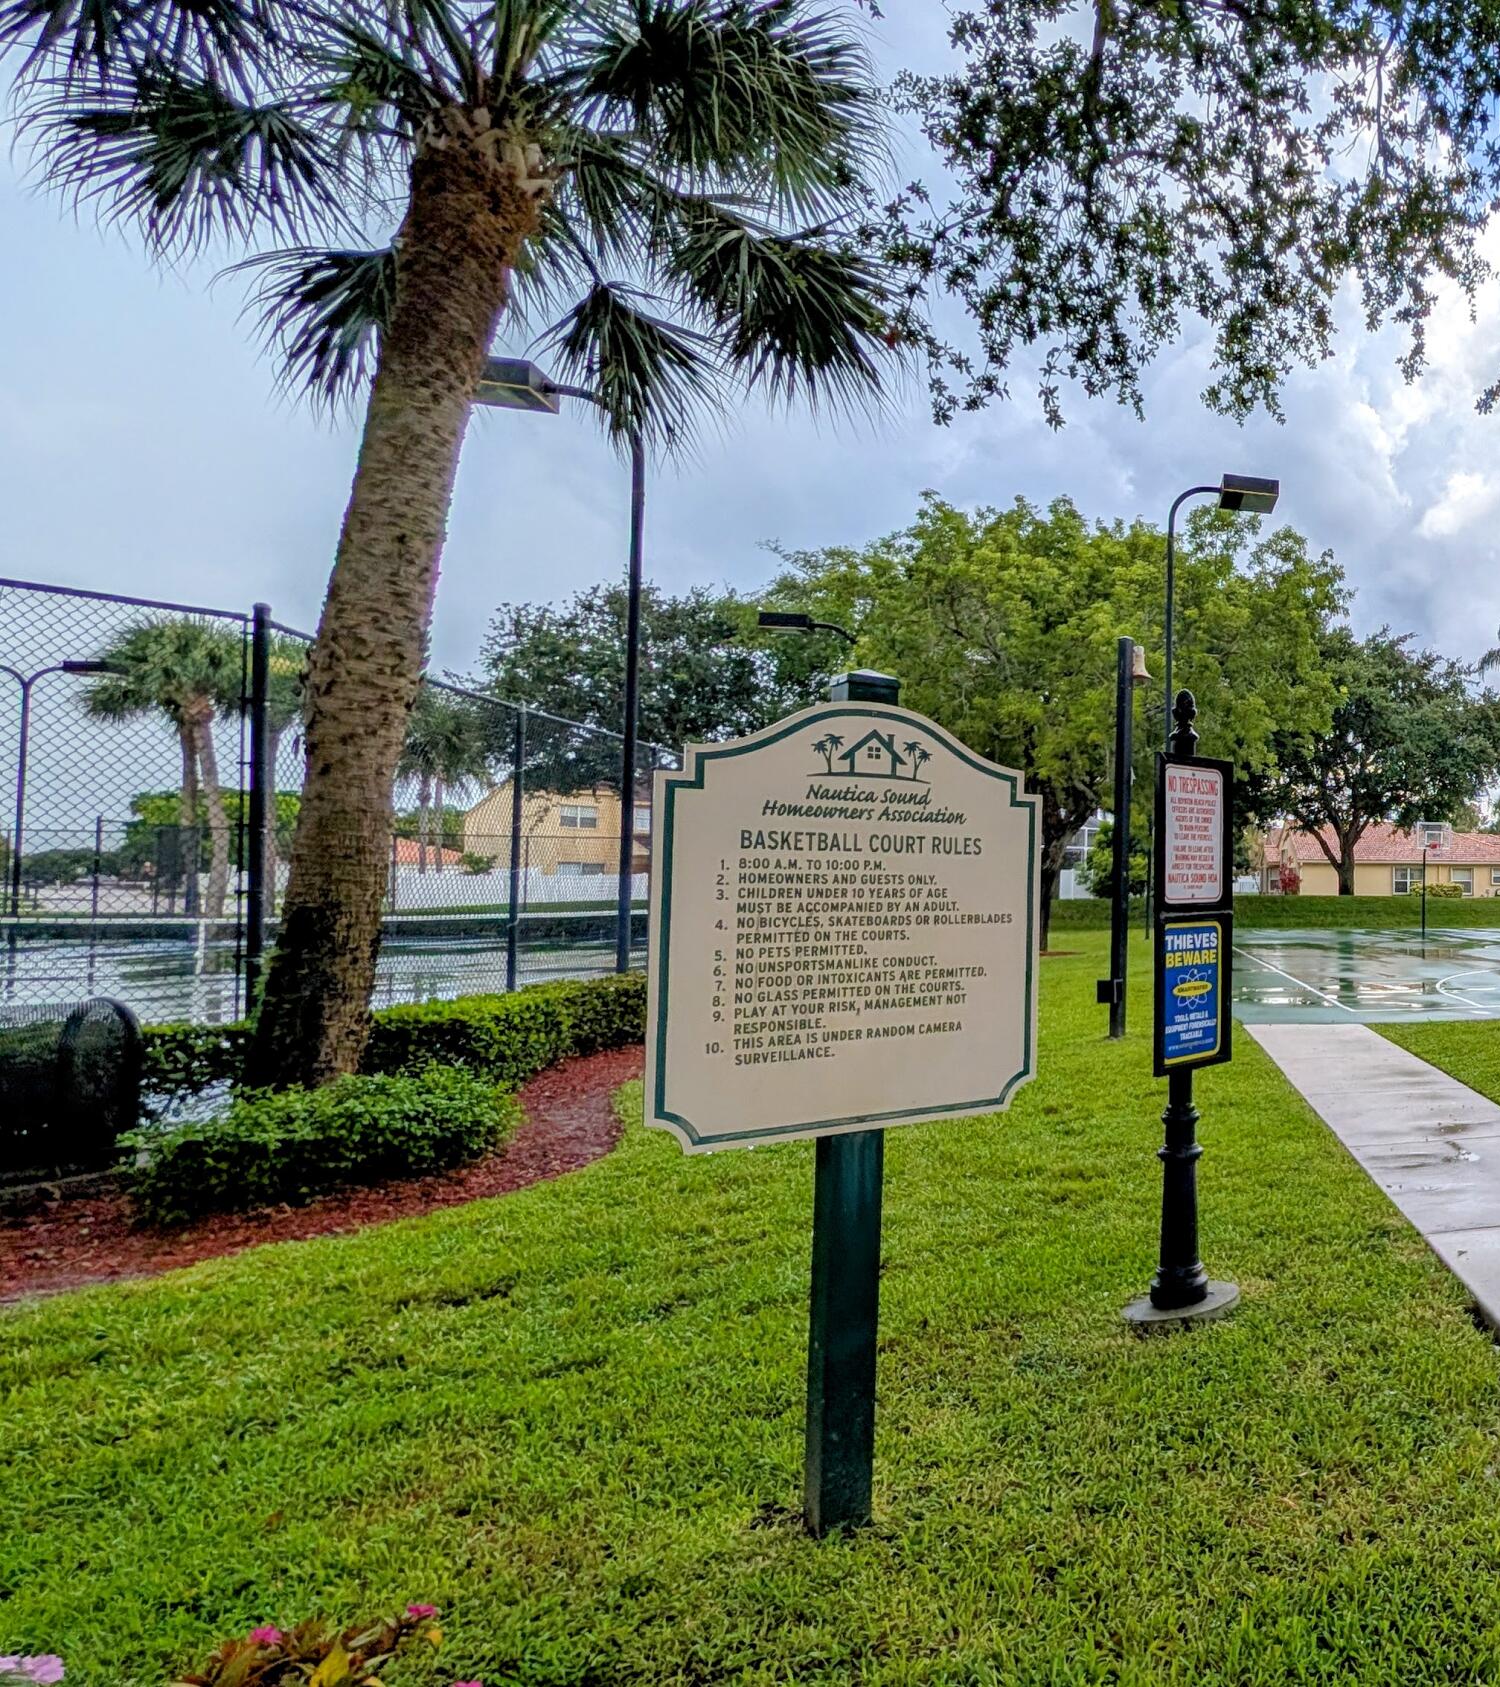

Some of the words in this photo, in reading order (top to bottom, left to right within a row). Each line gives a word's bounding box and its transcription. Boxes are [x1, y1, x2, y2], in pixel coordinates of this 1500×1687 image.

[806, 784, 879, 803] Nautica
[880, 788, 932, 806] Sound
[1168, 775, 1177, 793] NO
[1179, 777, 1218, 796] TRESPASSING
[762, 800, 875, 821] Homeowners
[877, 806, 967, 825] Association
[739, 829, 863, 852] BASKETBALL
[869, 834, 926, 854] COURT
[931, 836, 983, 856] RULES
[720, 859, 730, 871] 1.
[739, 858, 770, 869] 8:00
[774, 859, 802, 870] A.M.
[807, 859, 822, 870] TO
[826, 860, 860, 870] 10:00
[863, 860, 886, 871] P.M.
[716, 874, 730, 886] 2.
[738, 872, 828, 885] HOMEOWNERS
[832, 874, 857, 885] AND
[860, 874, 904, 885] GUESTS
[908, 874, 937, 886] ONLY.
[1168, 873, 1189, 883] NAUTICA
[1190, 873, 1207, 883] SOUND
[1208, 873, 1217, 883] HOA
[716, 889, 729, 901] 3.
[738, 887, 802, 899] CHILDREN
[807, 887, 848, 899] UNDER
[852, 888, 865, 899] 10
[869, 888, 906, 899] YEARS
[909, 888, 923, 899] OF
[927, 888, 948, 899] AGE
[736, 902, 772, 914] MUST
[776, 902, 792, 914] BE
[796, 901, 883, 913] ACCOMPANIED
[887, 902, 901, 913] BY
[905, 901, 920, 912] AN
[923, 901, 960, 912] ADULT.
[714, 919, 728, 931] 4.
[737, 916, 755, 929] NO
[760, 916, 824, 929] BICYCLES,
[828, 914, 912, 927] SKATEBOARDS
[915, 914, 930, 926] OR
[933, 913, 1013, 926] ROLLERBLADES
[736, 931, 810, 945] PERMITTED
[814, 930, 831, 942] ON
[835, 930, 858, 942] THE
[861, 930, 910, 941] COURTS.
[1165, 932, 1218, 951] THIEVES
[714, 950, 727, 962] 5.
[736, 947, 755, 960] NO
[758, 946, 791, 959] PETS
[795, 944, 868, 957] PERMITTED.
[1165, 950, 1217, 969] BEWARE
[713, 965, 727, 977] 6.
[735, 962, 754, 975] NO
[758, 957, 879, 973] UNSPORTSMANLIKE
[882, 955, 938, 968] CONDUCT.
[715, 980, 726, 992] 7.
[735, 978, 754, 989] NO
[758, 975, 793, 988] FOOD
[796, 974, 814, 986] OR
[818, 970, 896, 985] INTOXICANTS
[899, 969, 921, 982] ARE
[924, 966, 987, 980] PERMITTED.
[712, 996, 726, 1008] 8.
[734, 992, 753, 1004] NO
[757, 989, 799, 1003] GLASS
[803, 986, 871, 1000] PERMITTED
[875, 984, 891, 996] ON
[895, 983, 916, 995] THE
[919, 981, 965, 994] COURTS.
[712, 1011, 726, 1023] 9.
[734, 1006, 768, 1019] PLAY
[771, 1005, 788, 1016] AT
[791, 1003, 825, 1015] YOUR
[828, 1000, 861, 1016] RISK,
[864, 995, 943, 1011] MANAGEMENT
[946, 993, 967, 1005] NOT
[733, 1018, 827, 1035] RESPONSIBLE.
[705, 1042, 725, 1055] 10.
[733, 1036, 764, 1050] THIS
[767, 1033, 802, 1048] AREA
[806, 1033, 818, 1044] IS
[822, 1029, 863, 1042] UNDER
[866, 1025, 915, 1039] RANDOM
[918, 1021, 962, 1035] CAMERA
[735, 1046, 836, 1066] SURVEILLANCE.
